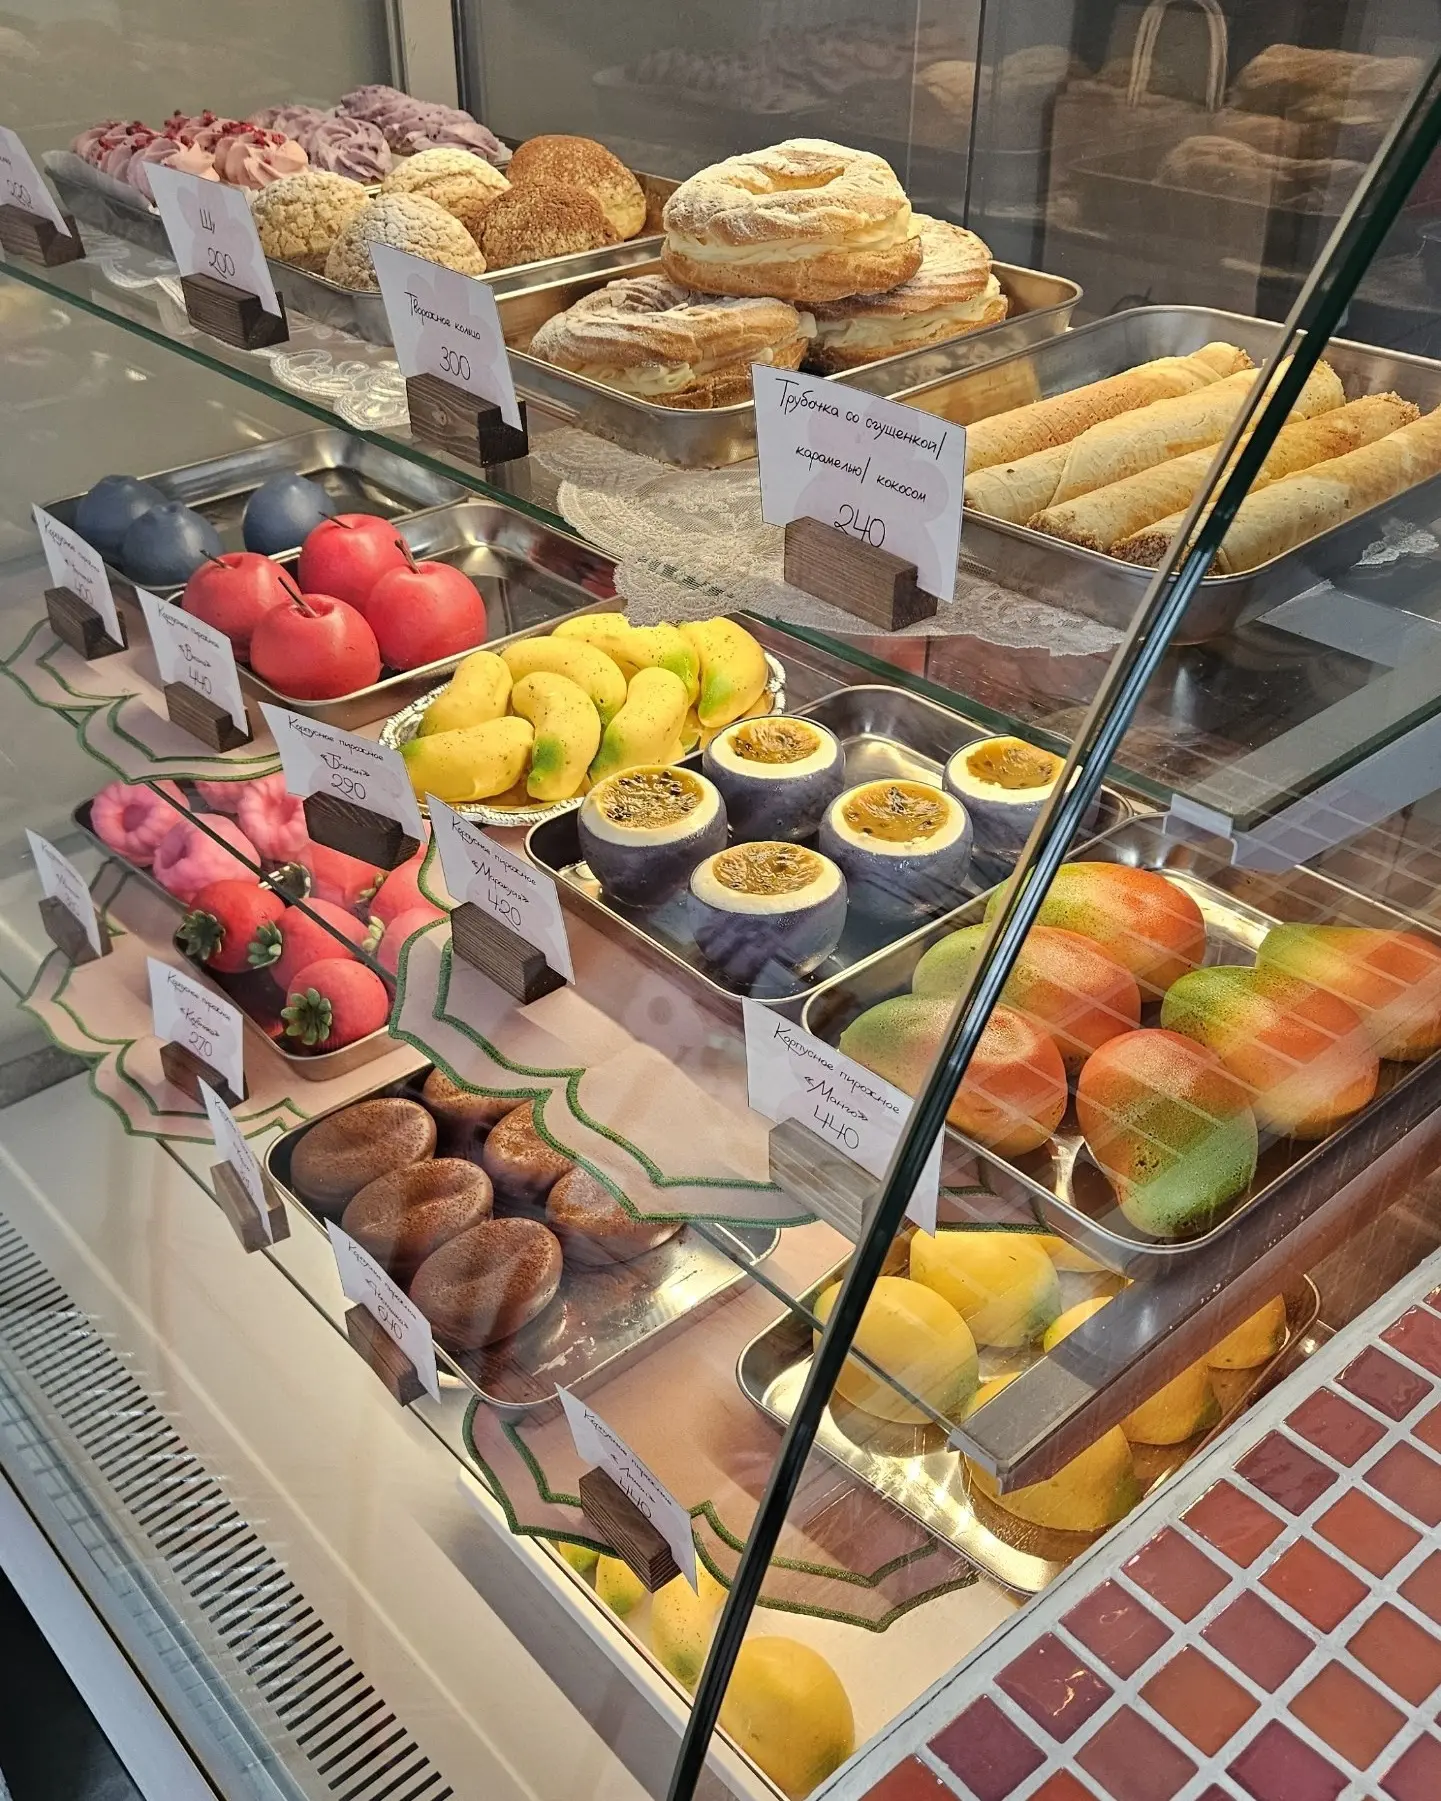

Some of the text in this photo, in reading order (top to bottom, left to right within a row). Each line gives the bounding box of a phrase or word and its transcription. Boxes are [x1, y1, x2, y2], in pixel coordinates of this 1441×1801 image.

[207, 247, 236, 280] 200
[404, 291, 481, 340] Творожное кольцо
[439, 346, 471, 381] 300
[775, 377, 840, 415] Трубочка
[845, 410, 860, 424] со
[876, 474, 927, 503] кокосом
[833, 503, 886, 548] 240
[188, 665, 213, 695] 440
[287, 714, 385, 761] Корпусное пирожное
[319, 751, 371, 777] «Банан»
[330, 772, 367, 800] 290
[450, 815, 538, 886] Корпусное пирожное
[486, 887, 522, 932] 420
[166, 970, 200, 1000] Корпусное
[187, 1030, 214, 1058] 270
[773, 1021, 901, 1115] Корпусное пирожное
[804, 1074, 869, 1122] «Манго»
[812, 1104, 860, 1150] 440
[583, 1408, 628, 1457] Корпусное
[618, 1476, 653, 1519] 440
